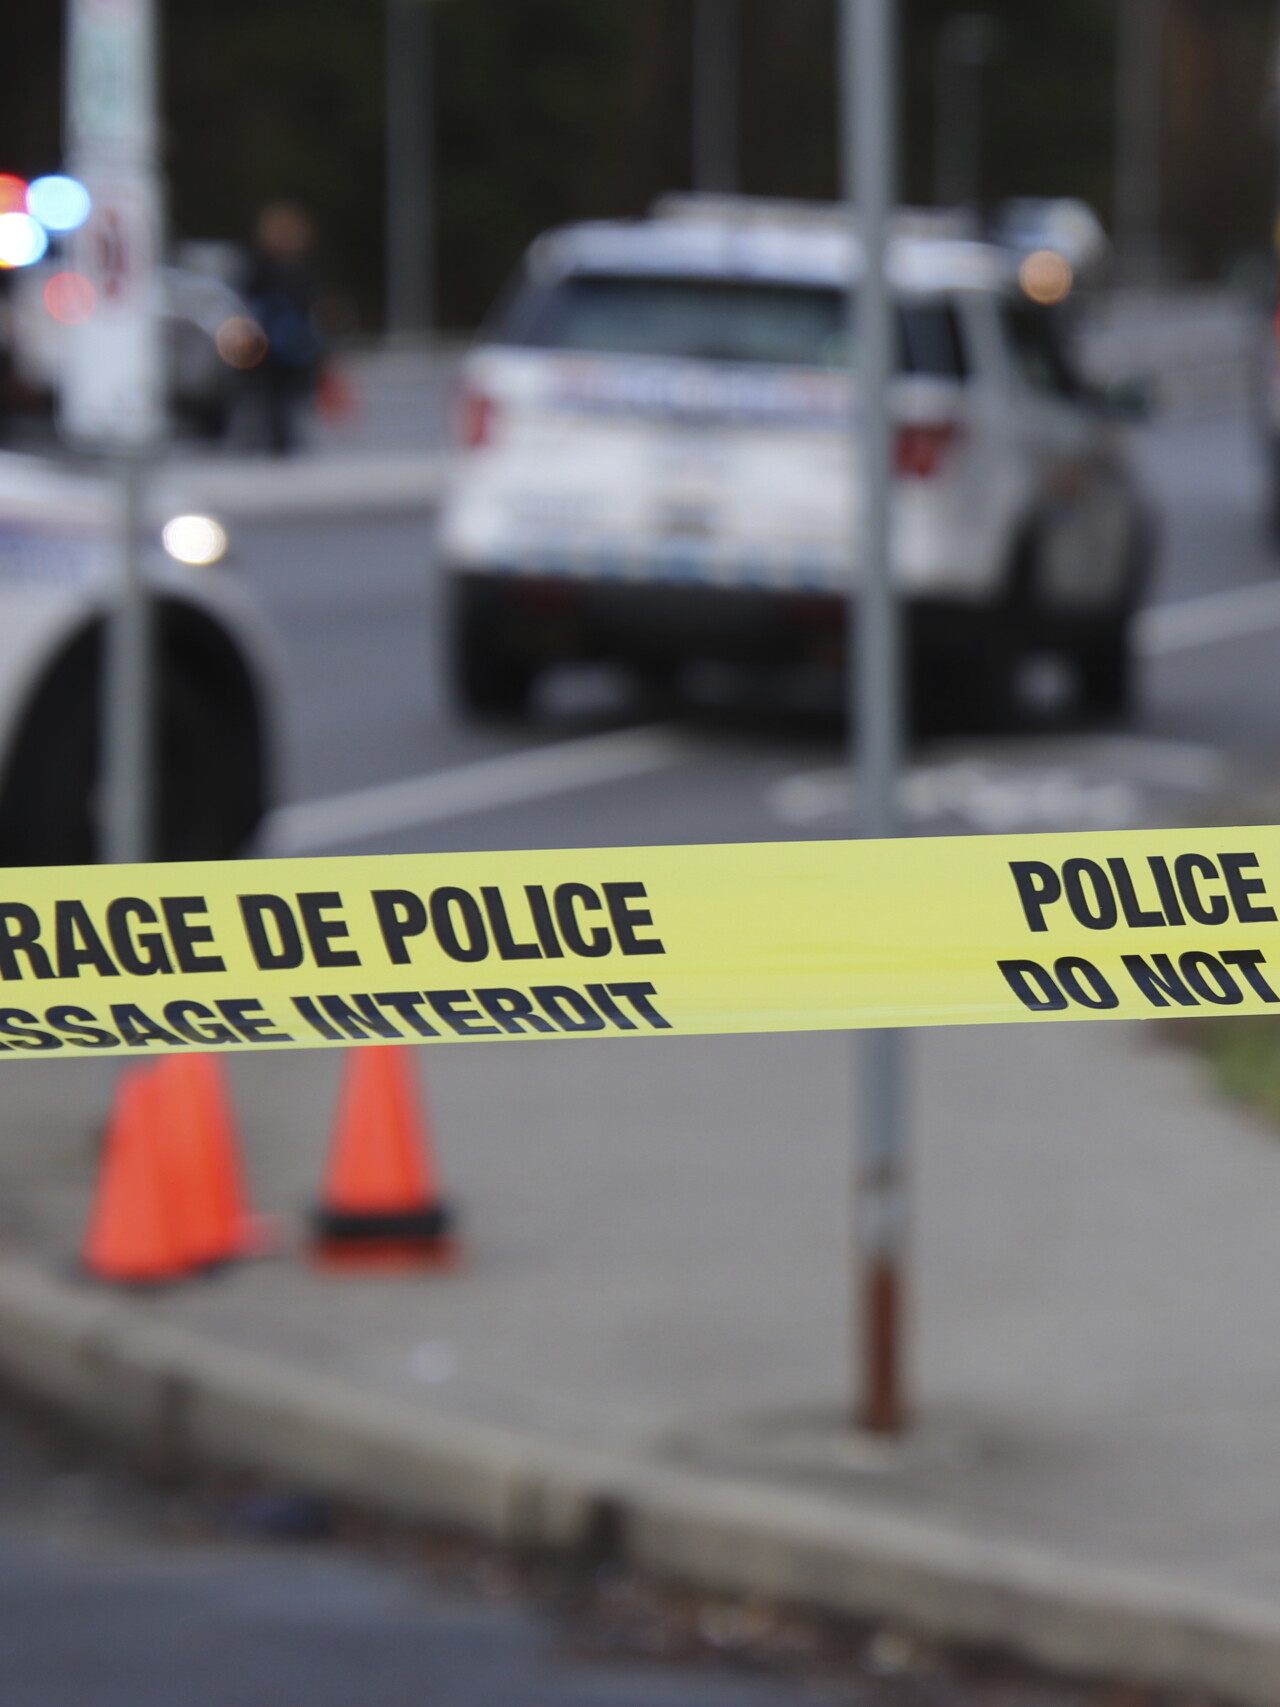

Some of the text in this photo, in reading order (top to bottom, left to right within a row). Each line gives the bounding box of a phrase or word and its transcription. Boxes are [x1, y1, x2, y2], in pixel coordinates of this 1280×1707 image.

[1008, 852, 1279, 933] POLICE
[0, 882, 666, 981] RAGE DE POLICE
[0, 981, 673, 1050] SSAGE INTERDIT
[996, 956, 1120, 1012] DO
